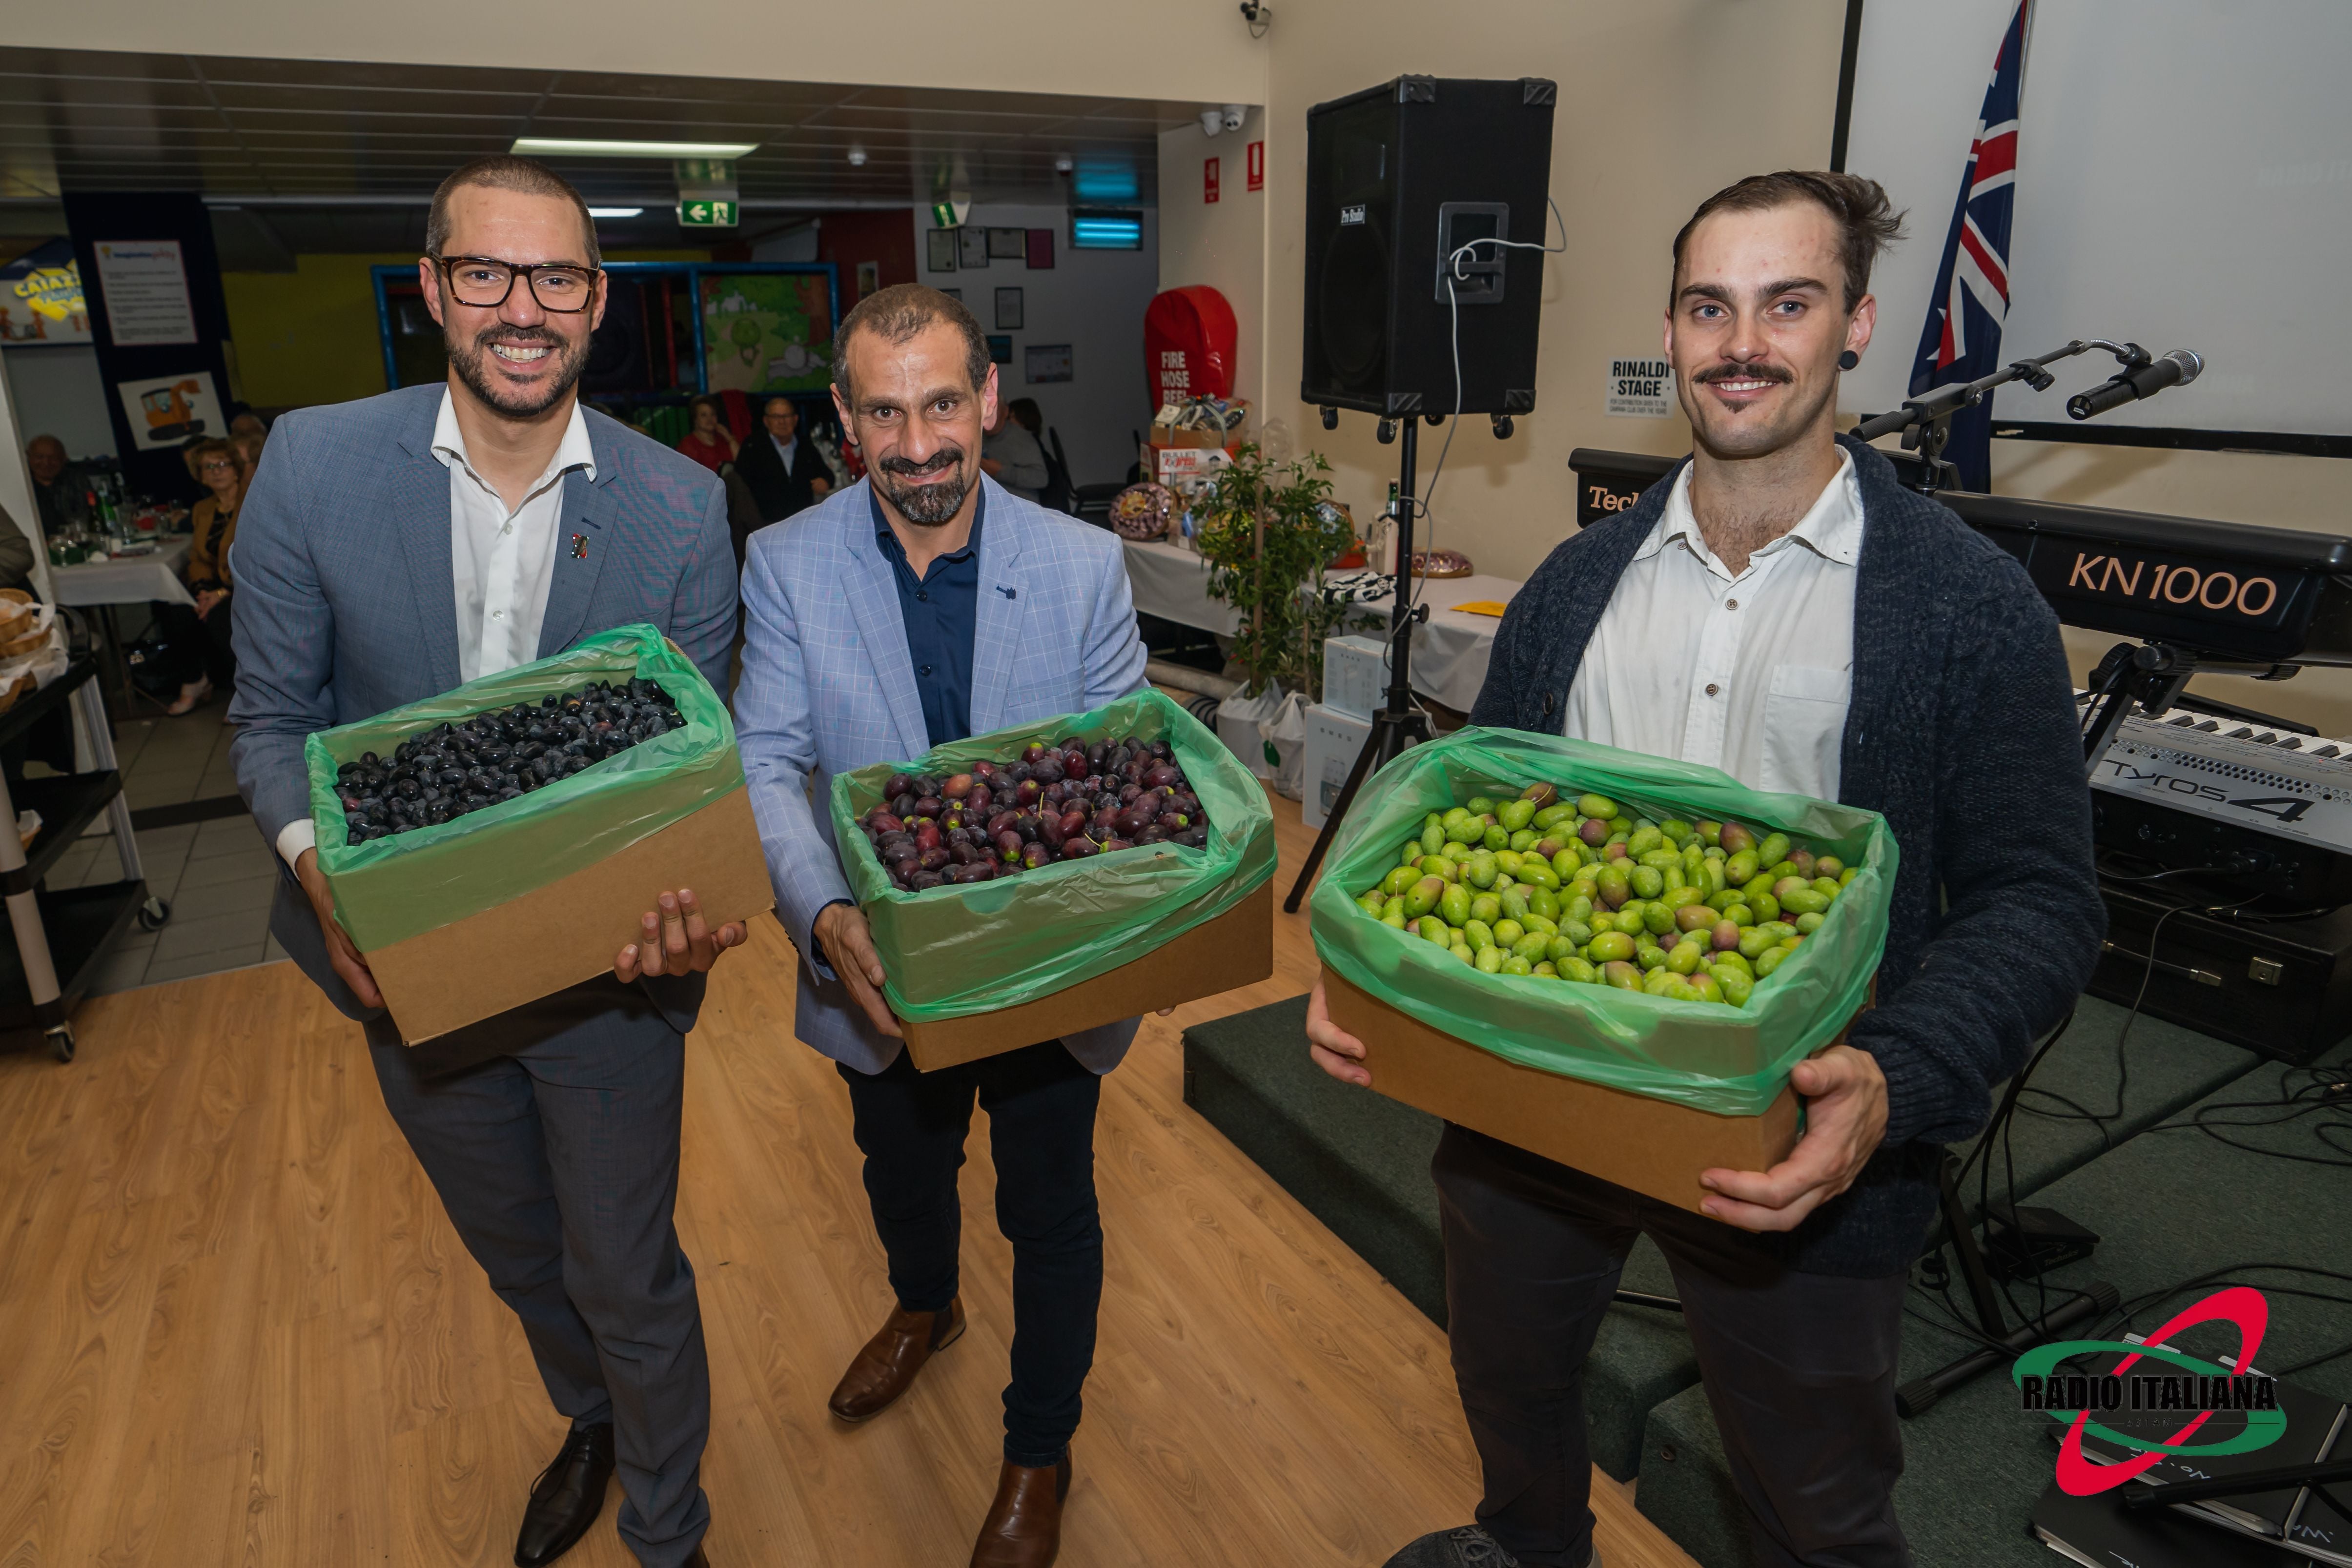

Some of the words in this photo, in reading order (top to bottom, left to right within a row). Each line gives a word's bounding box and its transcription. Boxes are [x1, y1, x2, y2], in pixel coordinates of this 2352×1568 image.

[1161, 351, 1186, 368] FIRE
[1613, 361, 1670, 378] RINALDI
[1160, 370, 1190, 388] HOSE
[1617, 379, 1661, 396] STAGE
[2068, 553, 2145, 595] KN
[2149, 564, 2277, 615] 1000
